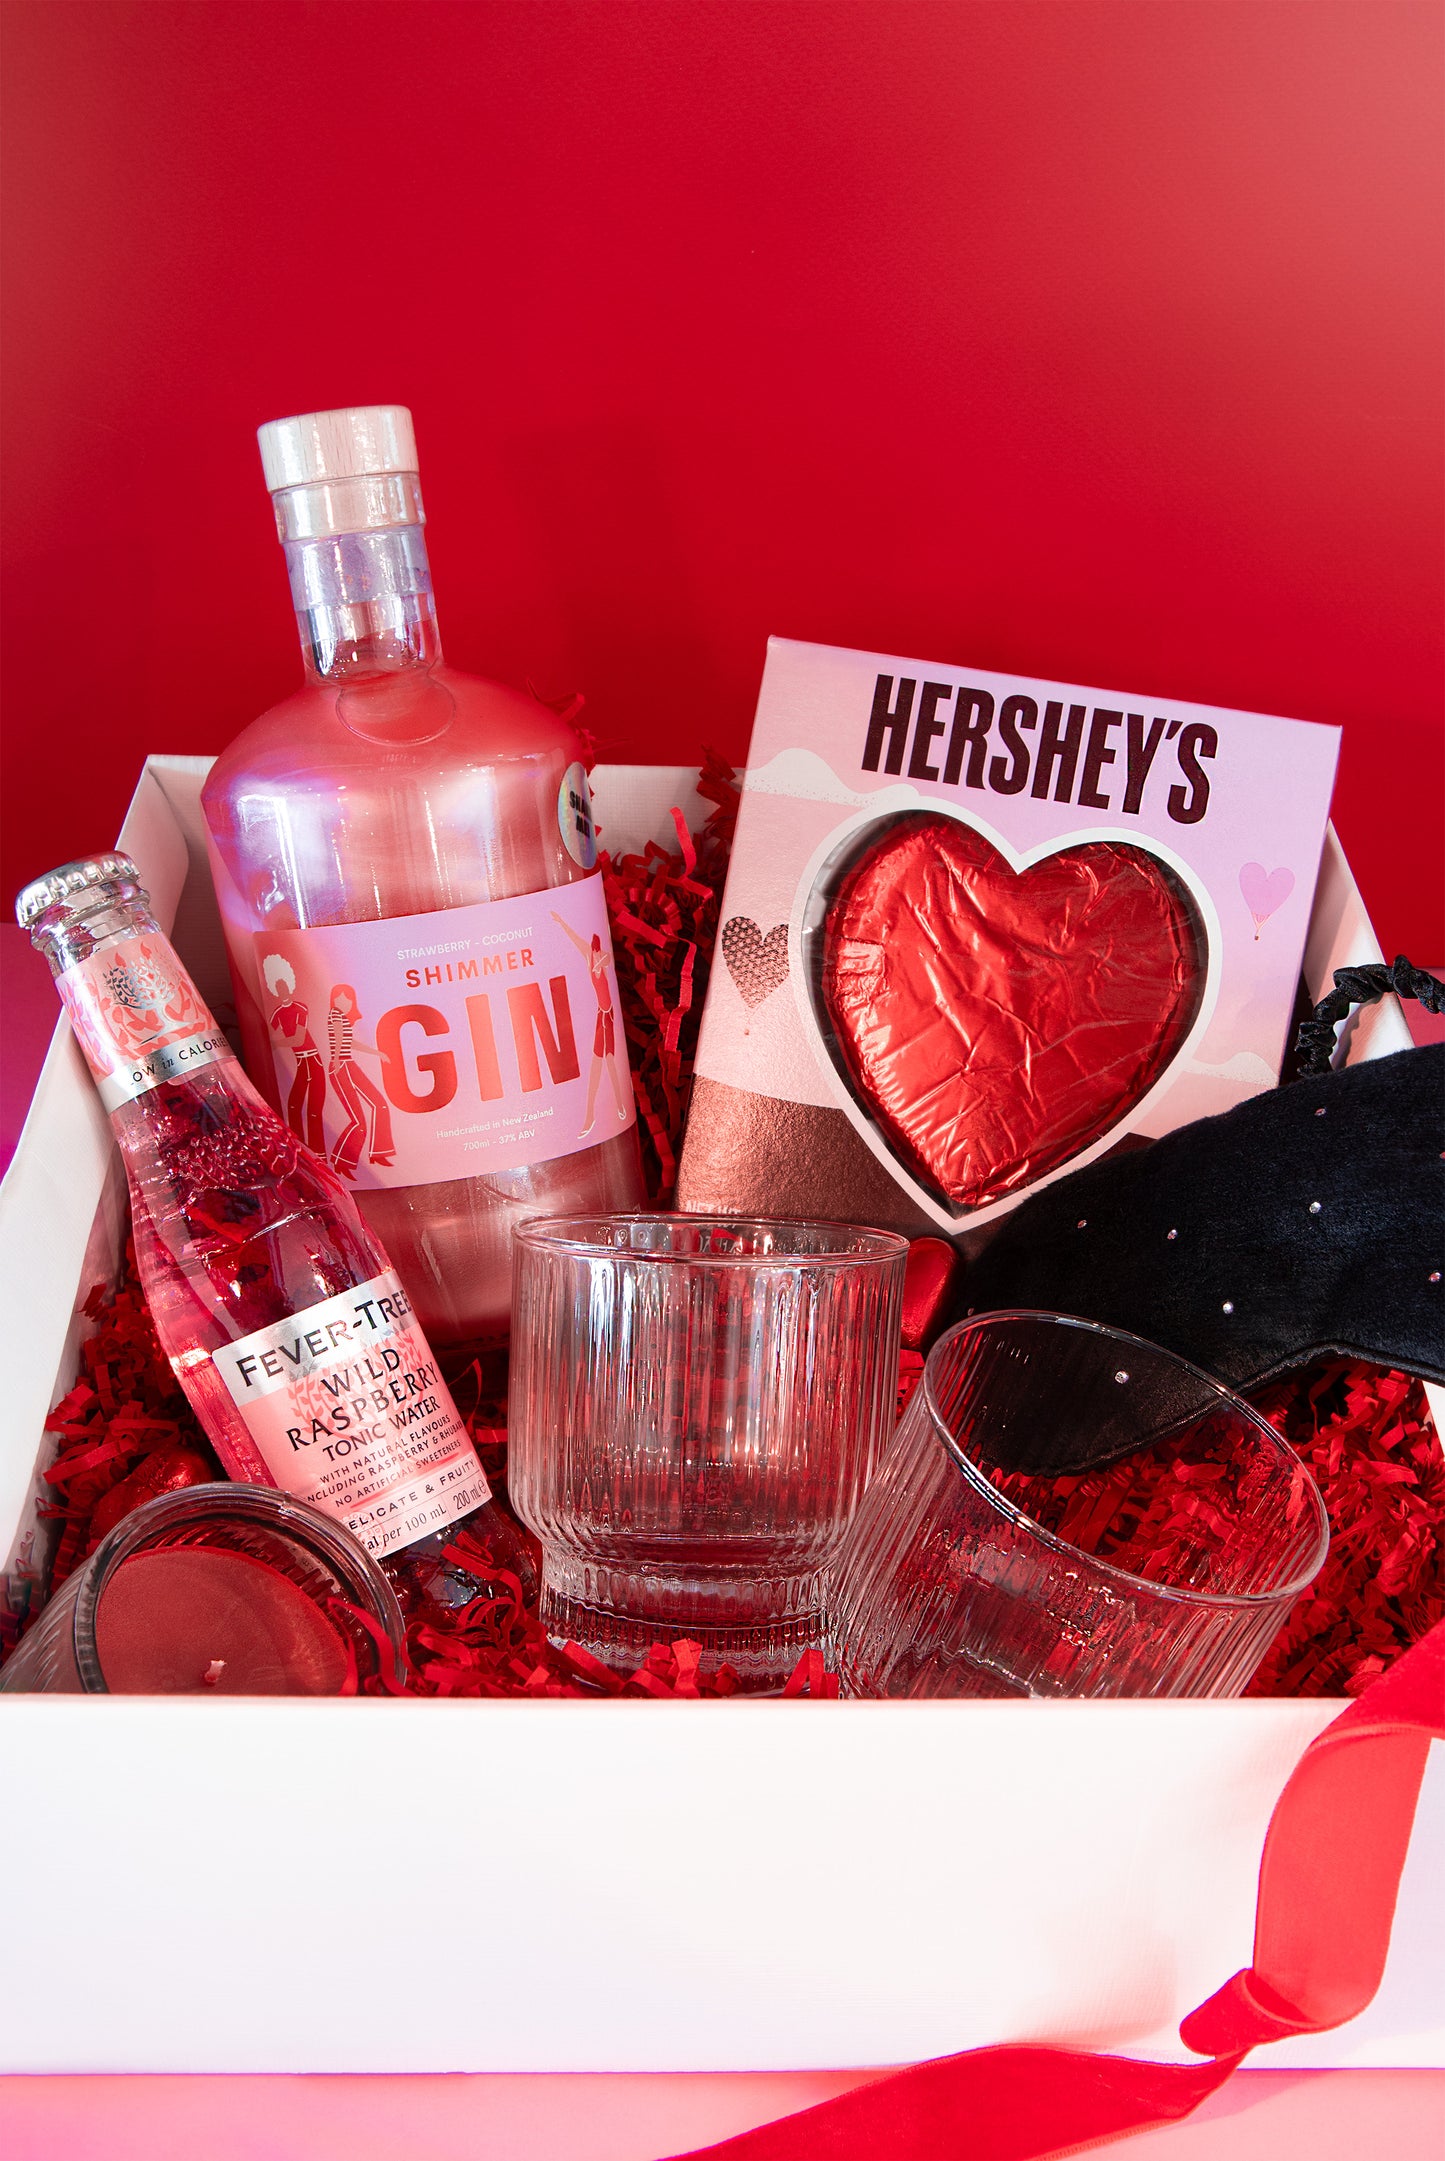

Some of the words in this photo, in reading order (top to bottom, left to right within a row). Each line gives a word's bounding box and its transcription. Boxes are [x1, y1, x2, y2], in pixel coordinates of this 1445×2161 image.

[861, 674, 1218, 825] HERSHEY'S
[397, 939, 471, 960] STRAWBERRY
[482, 927, 533, 946] COCONUT
[405, 948, 535, 988] SHIMMER
[131, 1063, 156, 1086] OW
[162, 1058, 174, 1070] in
[376, 975, 581, 1113] GIN
[436, 1121, 491, 1138] Handcrafted
[492, 1119, 501, 1129] in
[502, 1116, 521, 1127] New
[523, 1106, 554, 1122] Zealand
[463, 1139, 490, 1151] 700ml
[499, 1133, 517, 1145] 37%
[518, 1129, 536, 1141] ABV
[235, 1289, 412, 1387] FEVER-TREE
[320, 1348, 401, 1397] WILD
[285, 1361, 440, 1452] RASPBERRY
[322, 1423, 387, 1462] TONIC
[389, 1395, 441, 1430] WATER
[307, 1473, 366, 1502] NCLUDING
[368, 1439, 430, 1477] RASPBERRY
[432, 1436, 439, 1445] &
[319, 1465, 350, 1483] WITH
[353, 1438, 408, 1470] NATURAL
[409, 1414, 451, 1442] FLAVOURS
[335, 1494, 353, 1508] NO
[356, 1466, 414, 1499] ARTIFICIAL
[415, 1438, 461, 1469] SWEETENERS
[348, 1491, 418, 1530] ELICATE
[425, 1484, 435, 1494] &
[439, 1458, 475, 1486] FRUITY
[382, 1526, 401, 1548] per
[405, 1512, 427, 1532] 100
[429, 1503, 447, 1520] mL
[452, 1489, 471, 1511] 200
